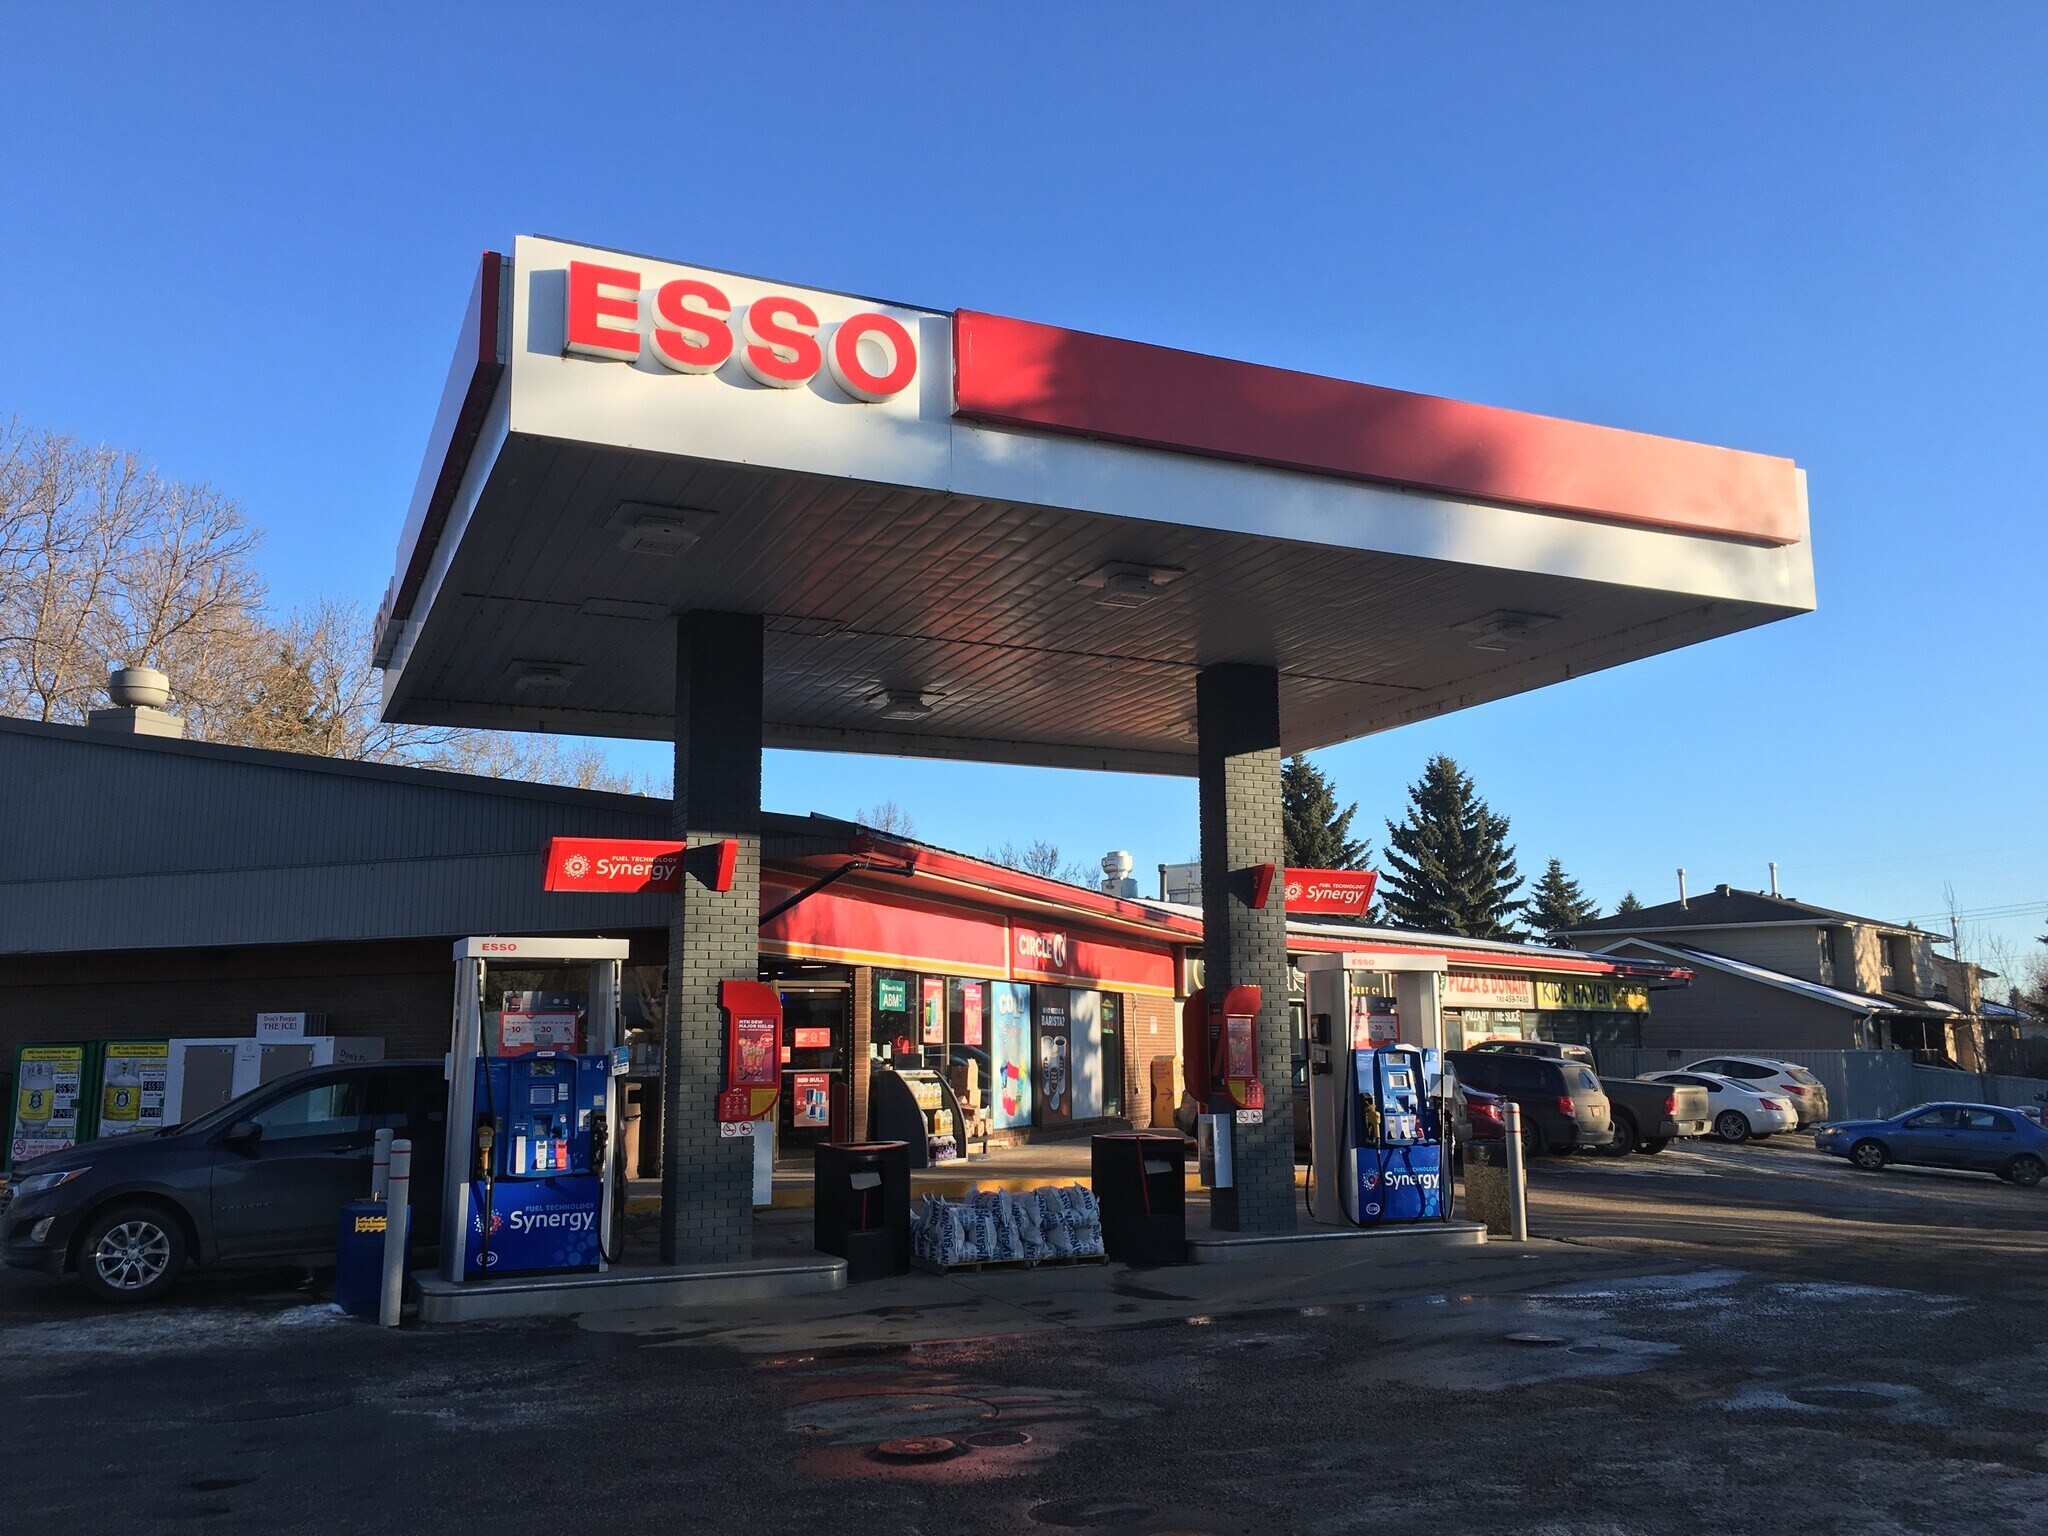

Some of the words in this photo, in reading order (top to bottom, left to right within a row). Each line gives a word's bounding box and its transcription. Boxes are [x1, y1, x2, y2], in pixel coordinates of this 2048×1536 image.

[567, 261, 916, 401] ESSO
[596, 858, 677, 880] Synergy
[1253, 876, 1259, 889] 2
[1306, 885, 1364, 904] Synergy
[482, 943, 517, 951] ESSO
[1019, 935, 1052, 959] CIRCLE
[1448, 971, 1480, 993] PIZZA
[1489, 973, 1528, 995] DONAIR
[1541, 980, 1568, 1003] KIDS
[1573, 982, 1610, 1004] HAVEN
[998, 994, 1025, 1018] COLD
[596, 1060, 605, 1070] 4
[1385, 1171, 1439, 1189] Synergy
[546, 1203, 595, 1211] TECHNOLOGY
[1081, 1187, 1093, 1210] SAND
[510, 1211, 595, 1234] Synergy
[930, 1201, 940, 1226] SAND
[944, 1224, 953, 1247] SAND
[975, 1224, 986, 1249] SAND
